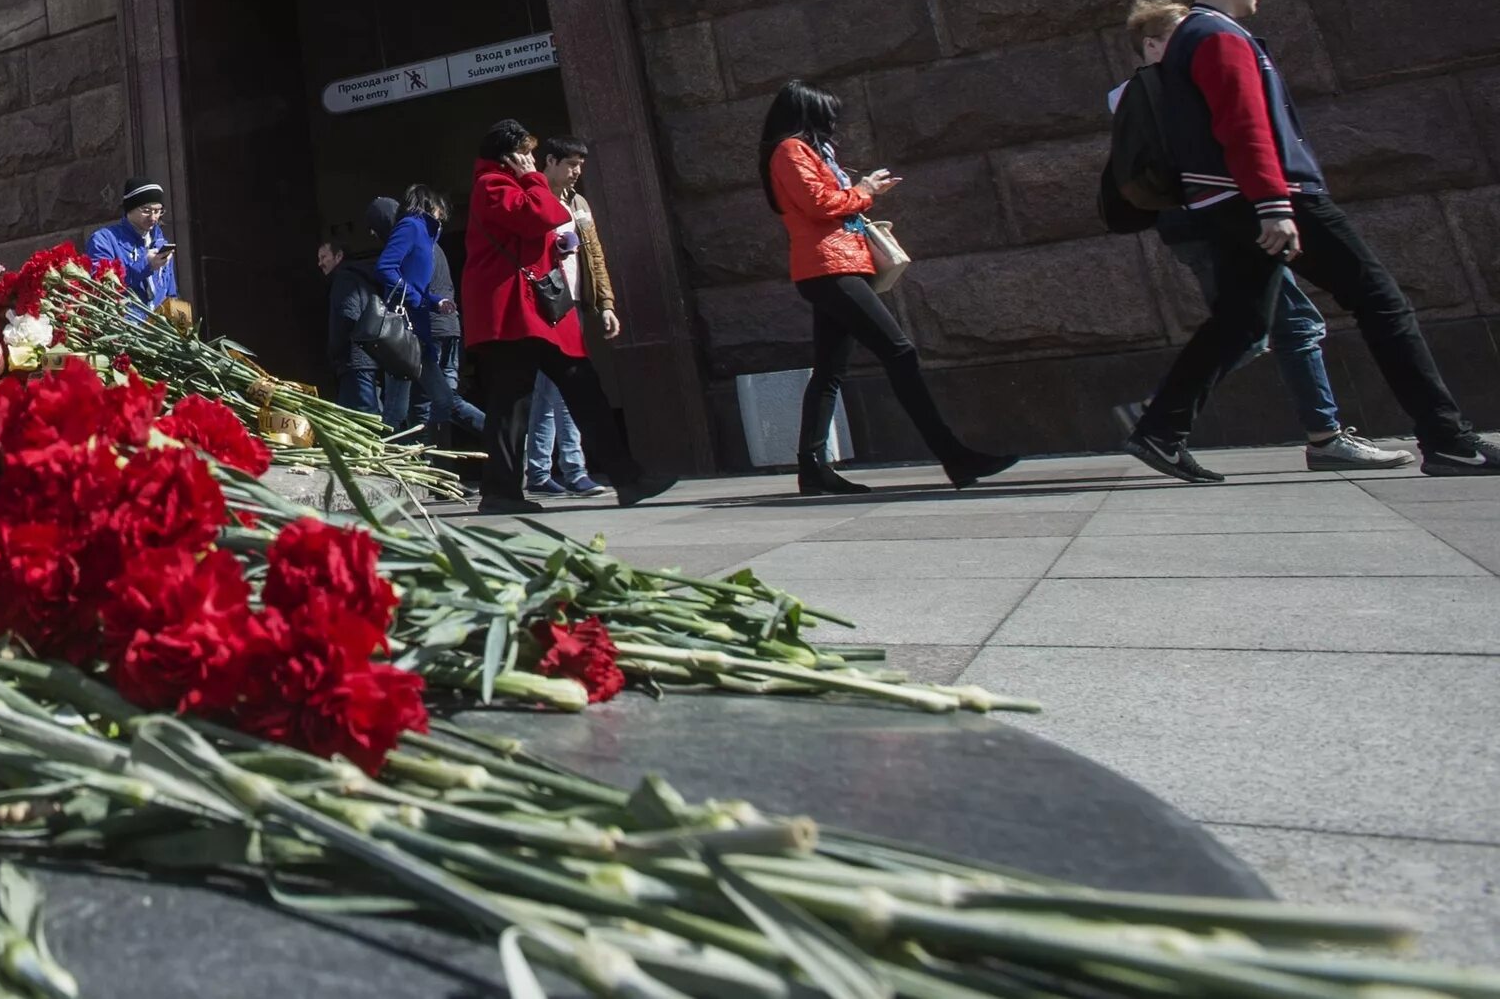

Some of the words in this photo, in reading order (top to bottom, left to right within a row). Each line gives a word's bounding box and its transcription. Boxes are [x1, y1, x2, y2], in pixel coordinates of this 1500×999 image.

[475, 50, 503, 63] Вход
[505, 48, 511, 57] в
[514, 40, 548, 55] метро
[467, 64, 506, 78] Subway
[508, 52, 551, 69] entrance
[338, 78, 381, 94] Прохода
[382, 73, 401, 84] нет
[352, 94, 364, 103] No
[366, 89, 389, 100] entry
